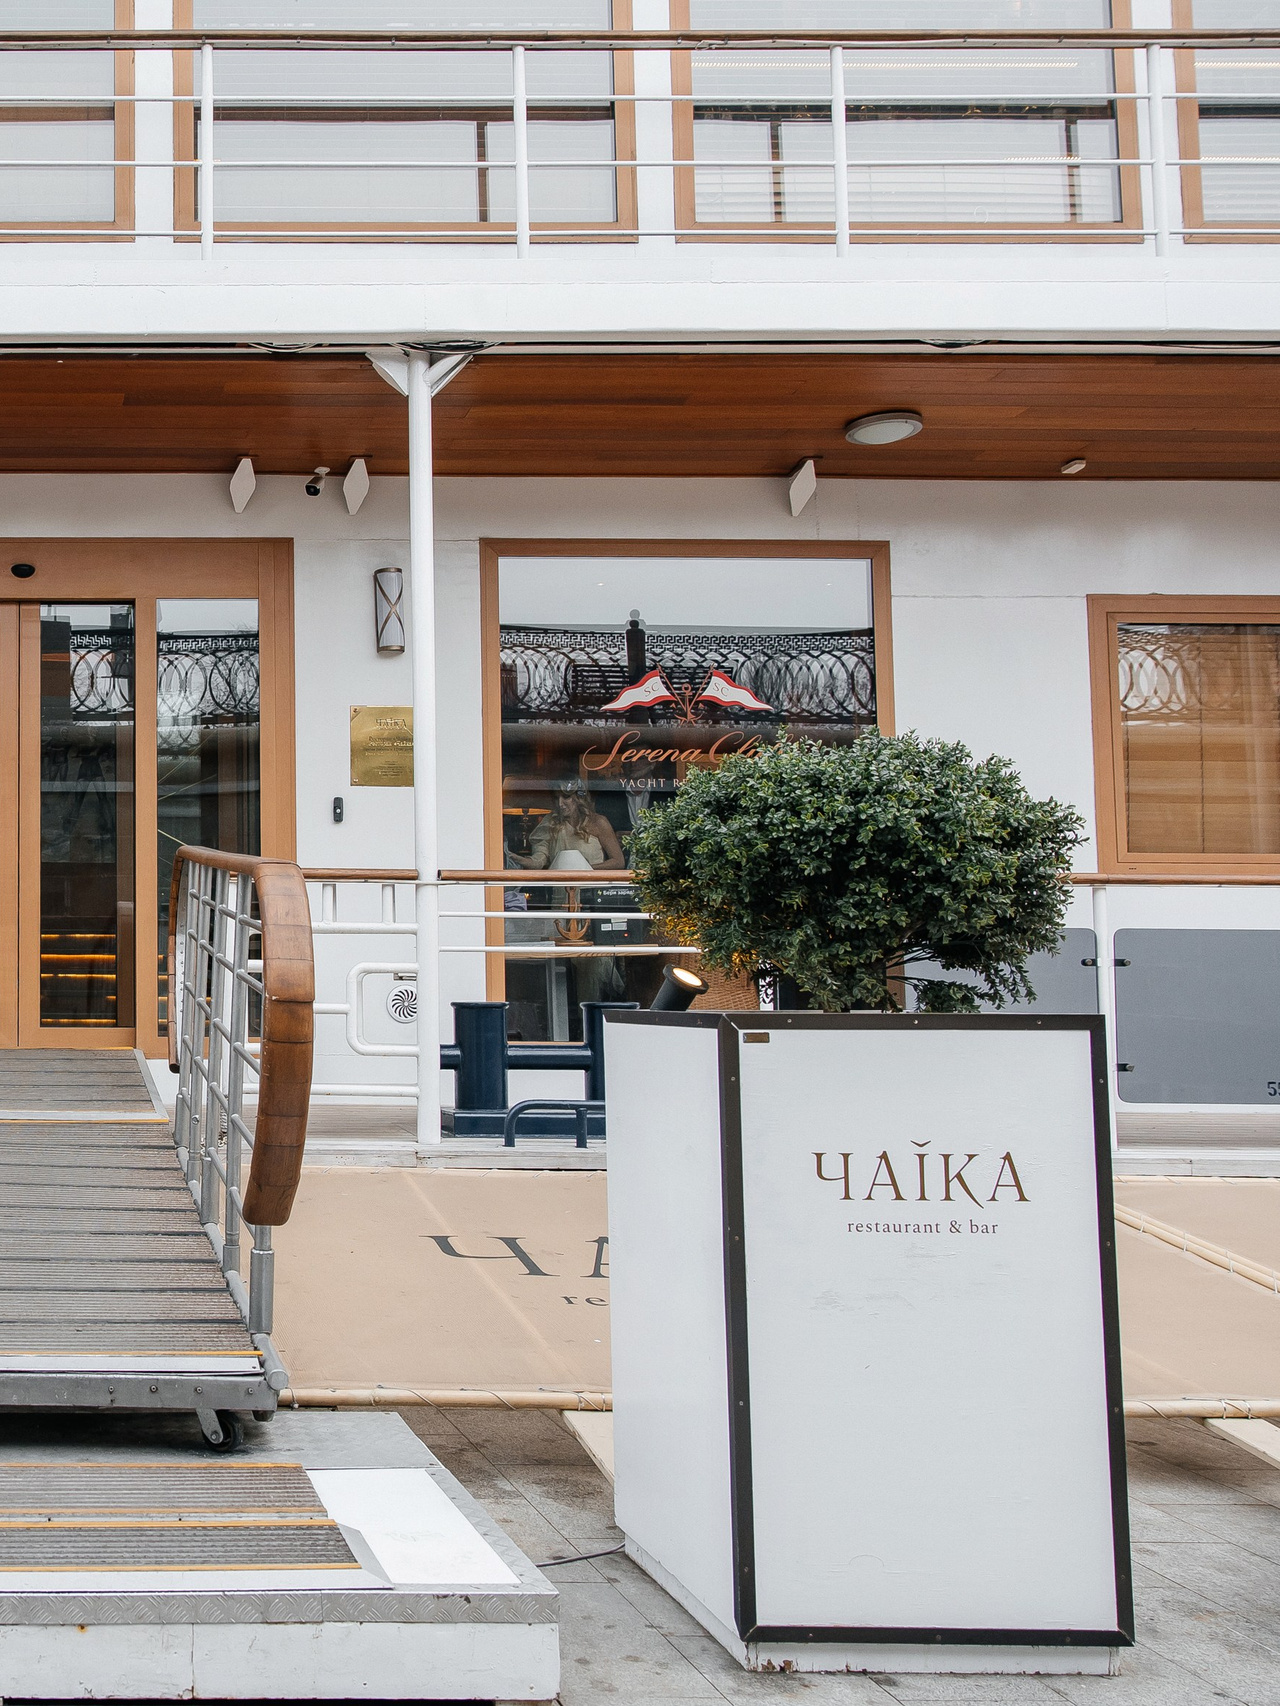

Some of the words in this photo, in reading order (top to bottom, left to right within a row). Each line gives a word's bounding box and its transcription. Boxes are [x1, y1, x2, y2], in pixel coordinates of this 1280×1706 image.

[643, 681, 660, 698] SC
[712, 682, 729, 697] SC
[582, 730, 707, 771] Serena
[619, 778, 666, 788] YACHT
[1267, 1081, 1280, 1097] 5
[847, 1221, 941, 1234] restaurant
[949, 1219, 962, 1234] &
[969, 1219, 998, 1234] bar
